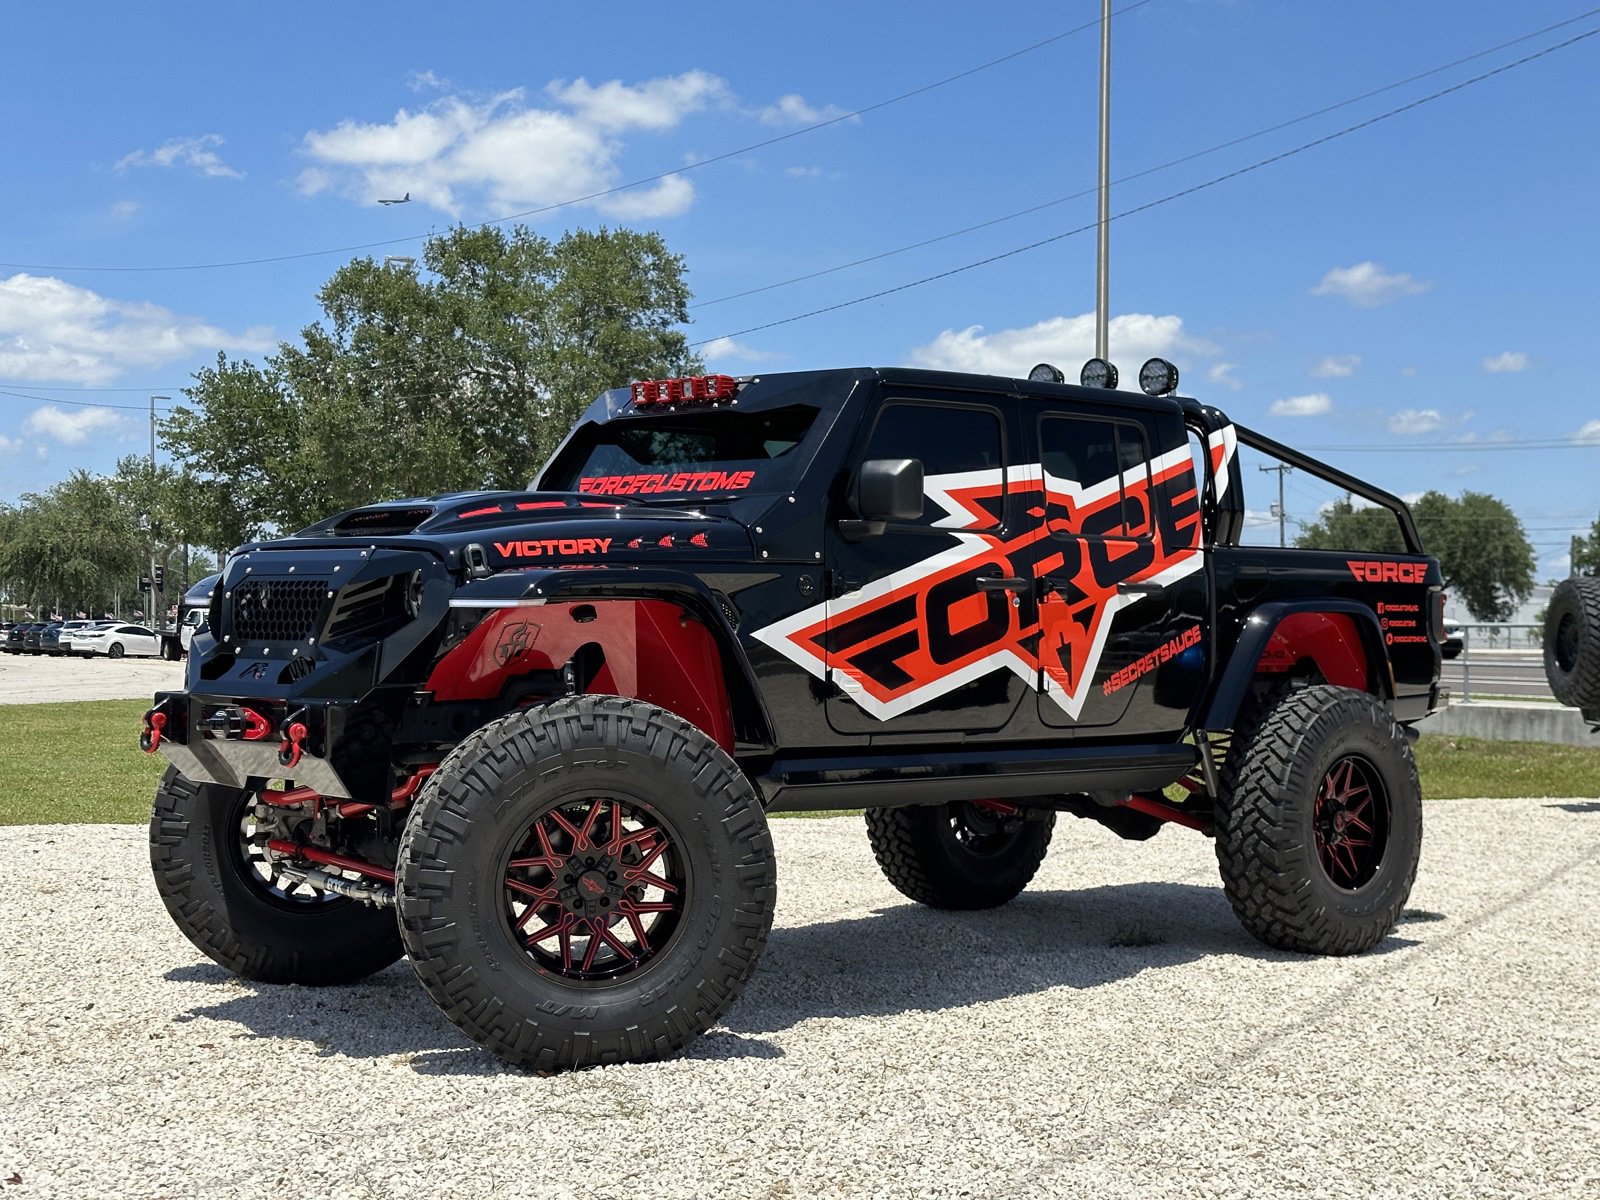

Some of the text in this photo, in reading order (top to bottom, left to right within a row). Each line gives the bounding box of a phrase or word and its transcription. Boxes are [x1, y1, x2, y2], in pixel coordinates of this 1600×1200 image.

[579, 471, 755, 494] FORCECUSTOMS
[494, 538, 612, 557] VICTORY
[806, 466, 1198, 690] FORCE
[1346, 561, 1429, 583] FORCE
[1103, 624, 1202, 696] #SECRETSAUCE
